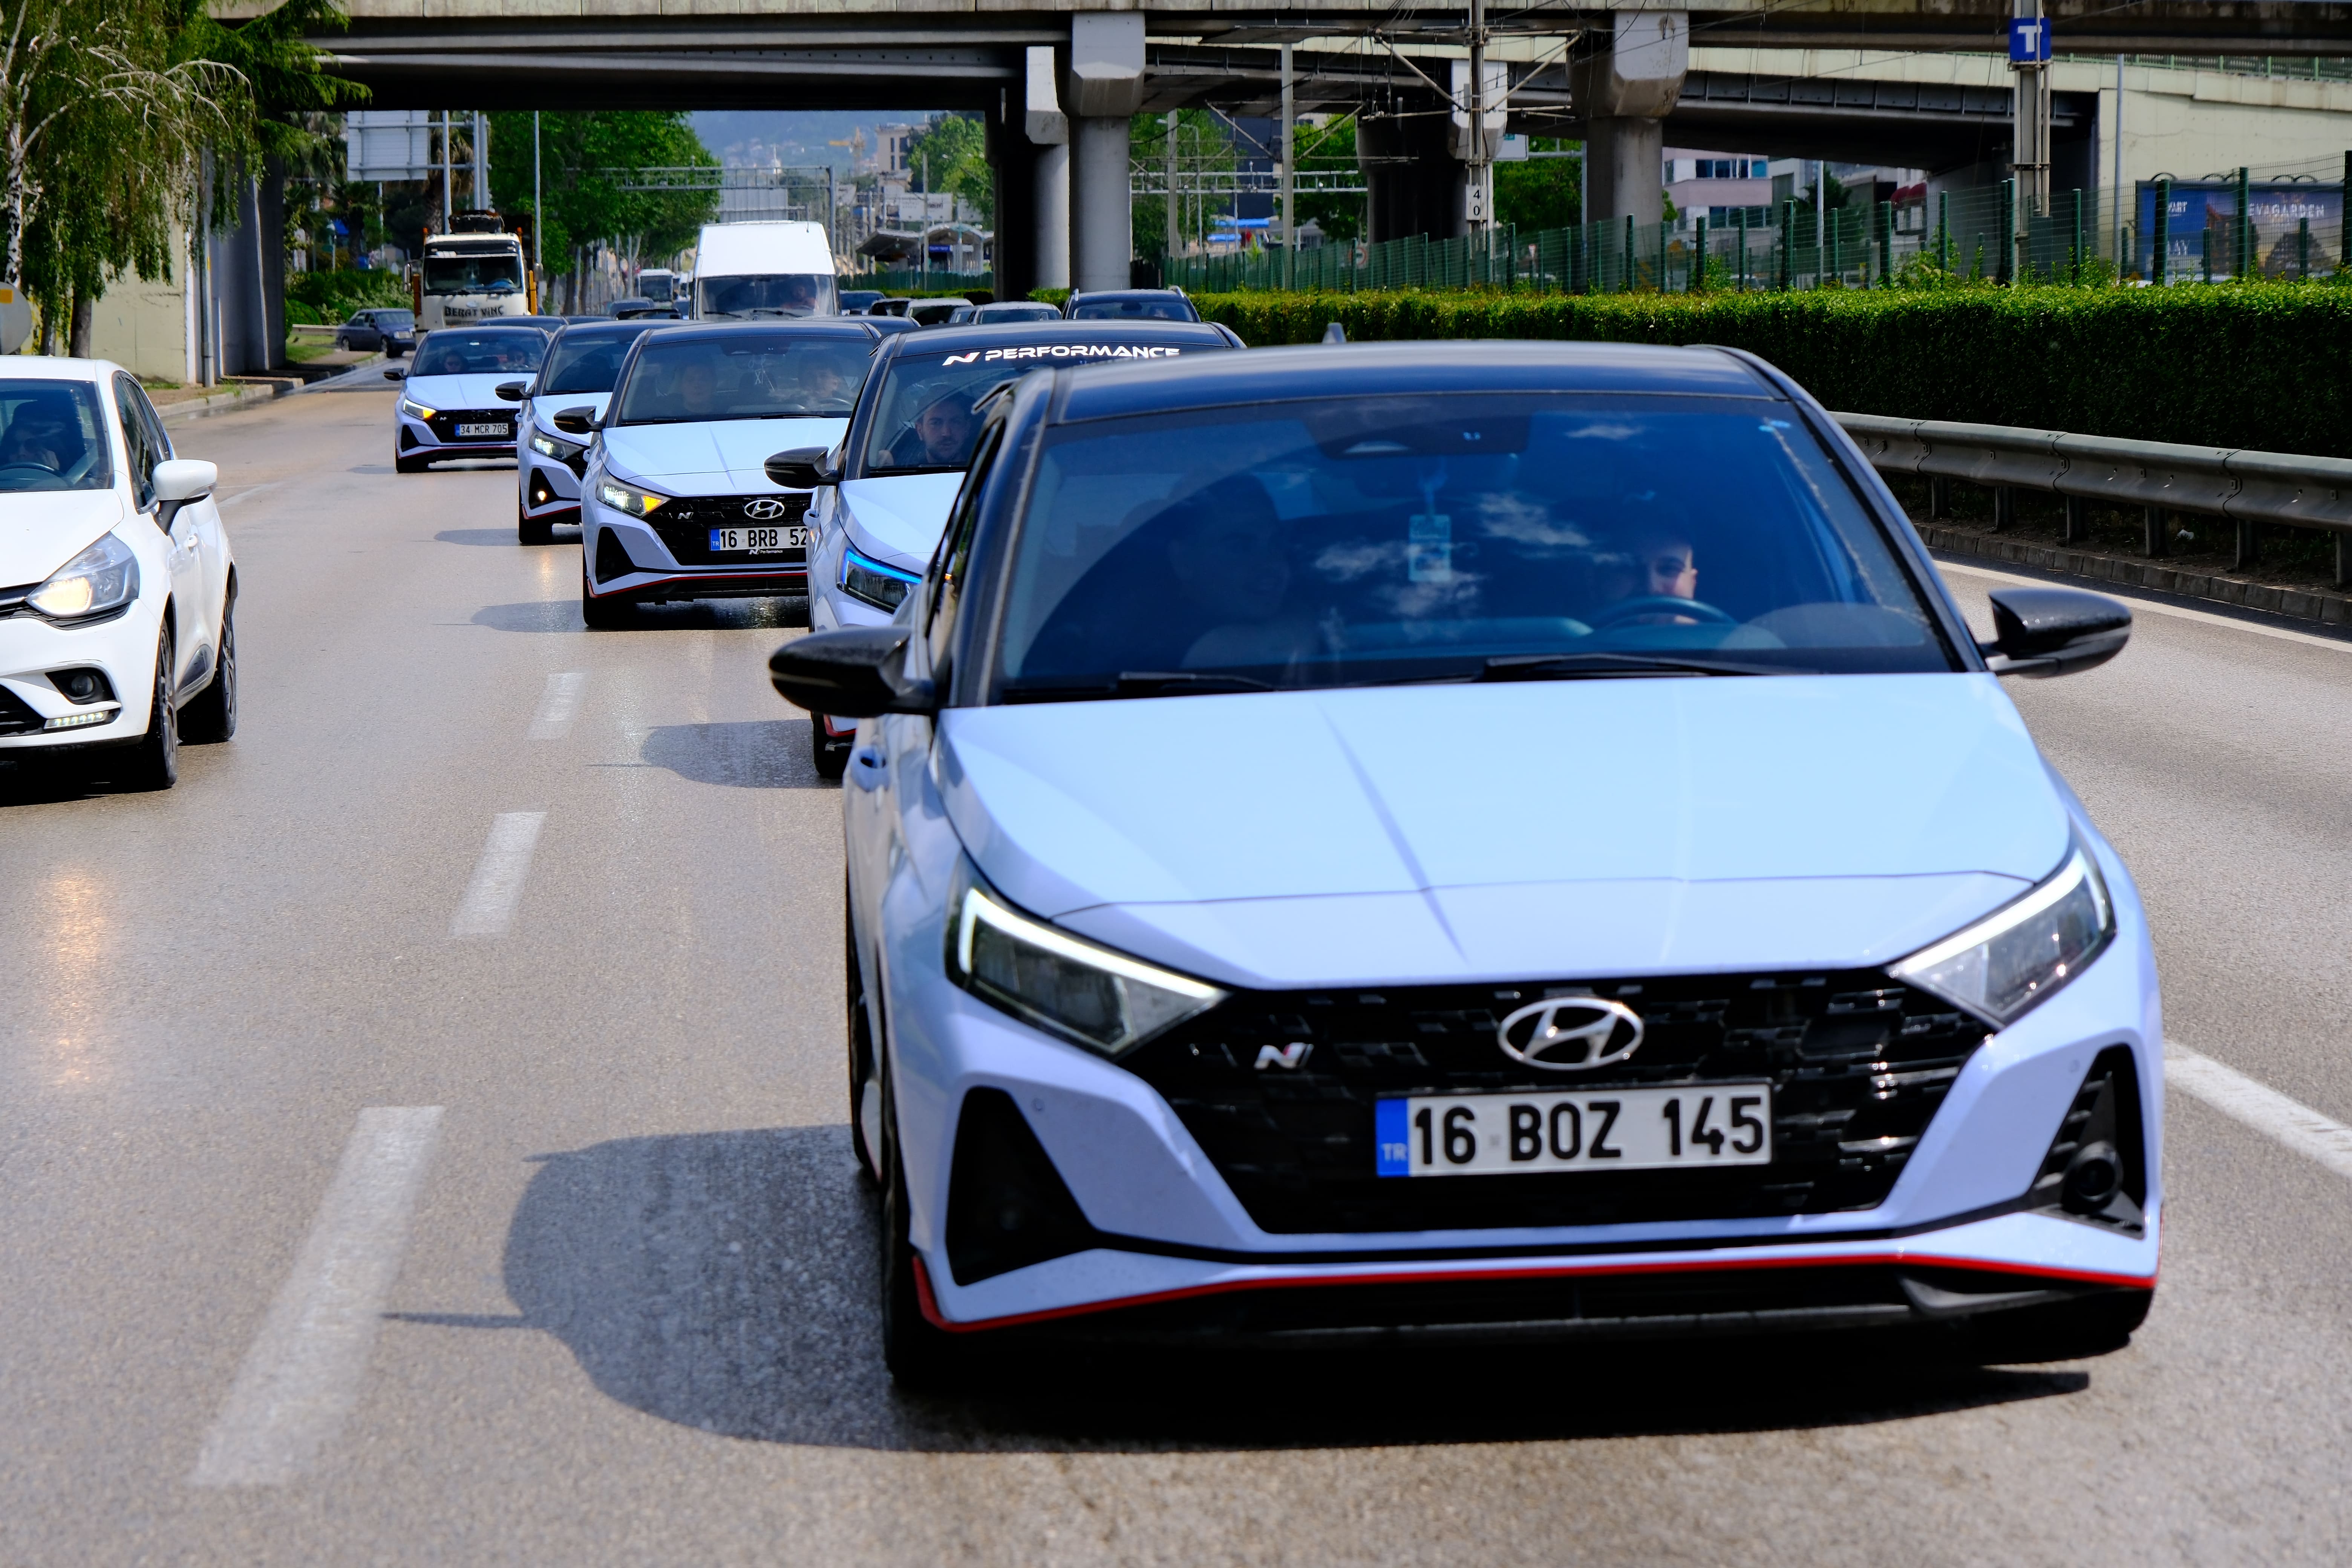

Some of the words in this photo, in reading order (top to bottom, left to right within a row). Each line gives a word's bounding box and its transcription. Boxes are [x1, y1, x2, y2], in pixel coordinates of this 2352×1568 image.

[444, 306, 478, 317] BERAT
[985, 346, 1180, 361] PERFORMANCE
[461, 426, 470, 434] 34
[475, 425, 489, 433] MCR
[493, 424, 507, 433] 705
[721, 530, 737, 548] 16
[748, 529, 778, 547] BRB
[1381, 1143, 1408, 1161] TR
[1415, 1106, 1476, 1164] 16
[1510, 1101, 1621, 1161] BOZ
[1664, 1096, 1763, 1155] 145
